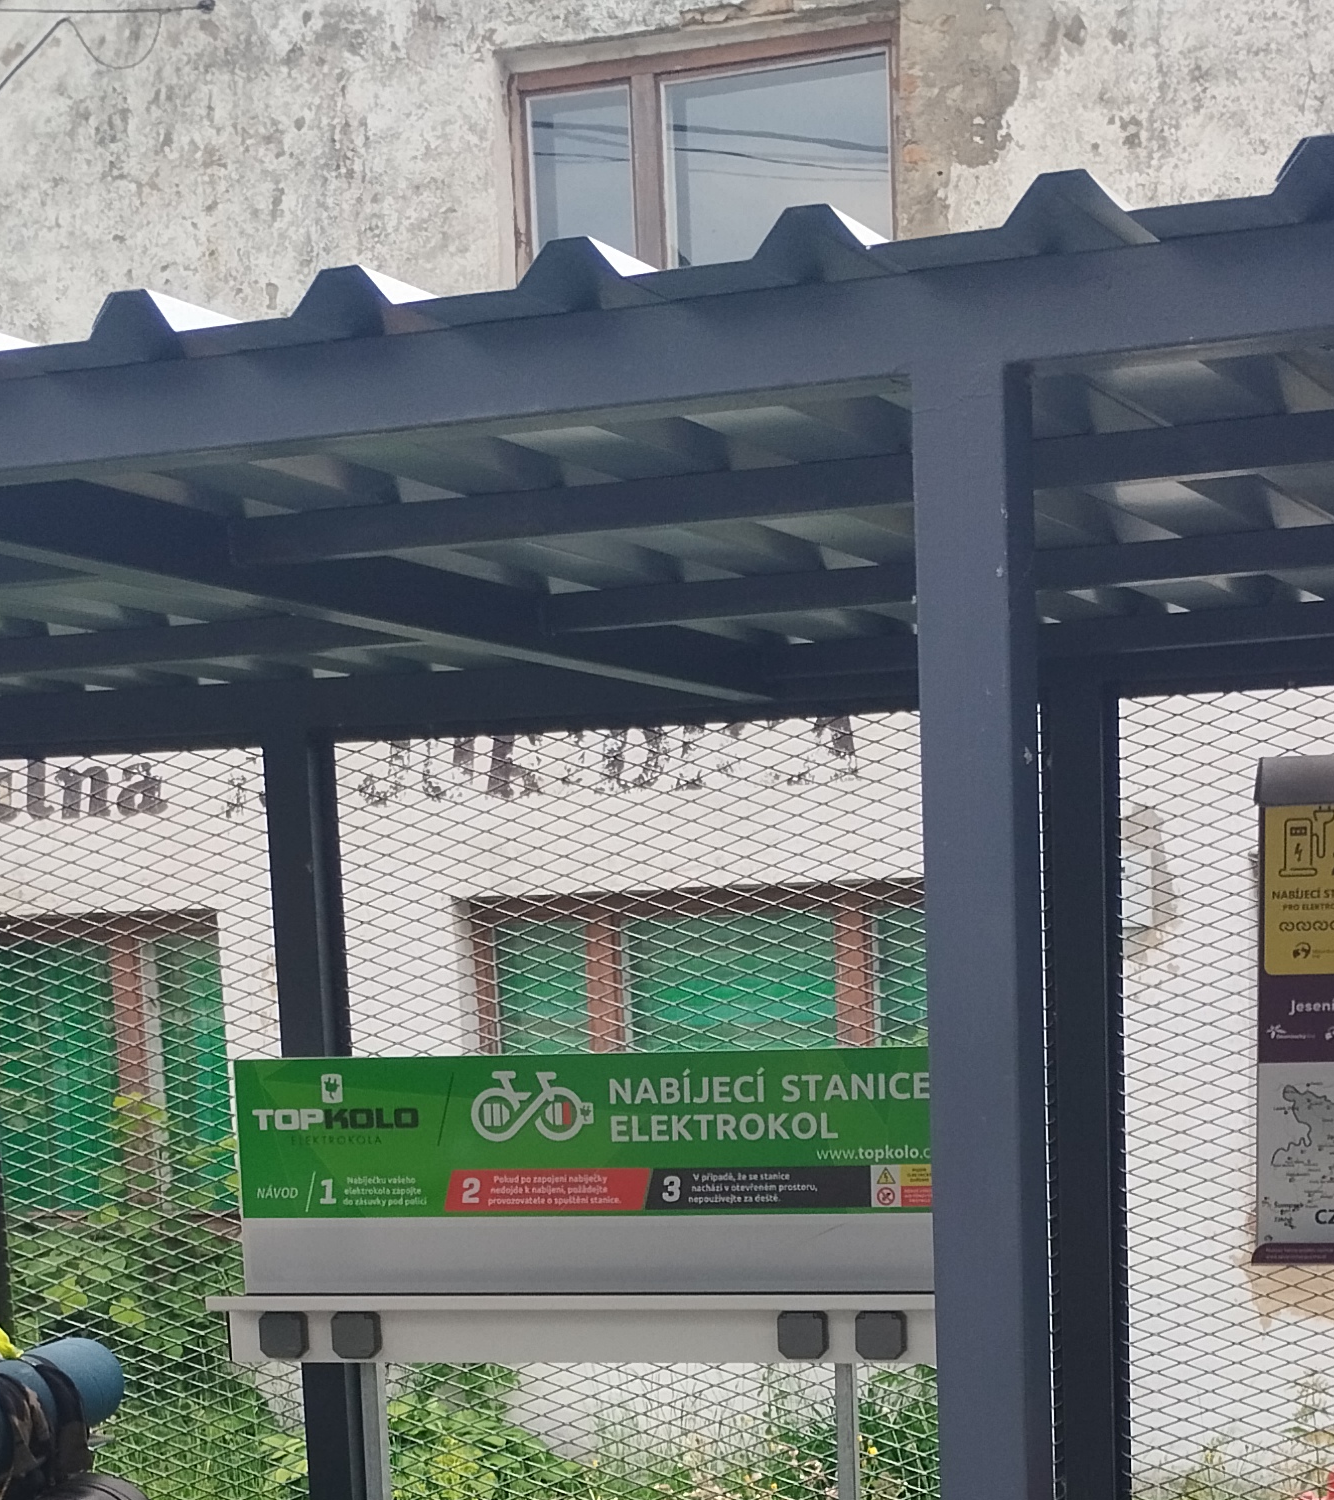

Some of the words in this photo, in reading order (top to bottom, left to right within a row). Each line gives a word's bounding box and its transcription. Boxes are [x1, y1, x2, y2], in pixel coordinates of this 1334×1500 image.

[1272, 887, 1321, 900] NABÍJECÍ
[1282, 903, 1299, 911] PRO
[609, 1067, 765, 1105] NABÍJECÍ
[782, 1072, 931, 1101] STANICE
[252, 1108, 419, 1131] TOPKOLO
[611, 1112, 838, 1142] ELEKTROKOL
[291, 1135, 382, 1146] ELEKTROKOLA
[347, 1175, 386, 1186] Nabíječku
[388, 1175, 416, 1185] vašeho
[494, 1175, 519, 1184] Pokud
[521, 1176, 531, 1185] po
[533, 1174, 567, 1185] zapojení
[568, 1173, 607, 1184] nabíječky
[692, 1173, 700, 1181] V
[701, 1173, 736, 1183] případě,
[737, 1172, 747, 1181] že
[760, 1171, 790, 1181] stanice
[256, 1184, 299, 1199] NÁVOD
[320, 1178, 337, 1205] 1
[344, 1186, 390, 1196] elektrokola
[392, 1187, 422, 1198] zapojte
[462, 1177, 481, 1204] 2
[490, 1185, 523, 1196] nedojde
[524, 1185, 530, 1194] k
[567, 1184, 608, 1195] požádejte
[662, 1175, 681, 1202] 3
[691, 1183, 723, 1192] nachází
[731, 1182, 777, 1192] otevřeném
[778, 1183, 818, 1193] prostoru,
[343, 1197, 351, 1206] do
[354, 1197, 386, 1207] zásuvky
[388, 1197, 403, 1207] pod
[488, 1196, 545, 1207] provozovatele
[554, 1195, 589, 1206] spuštění
[590, 1195, 622, 1204] stanice.
[688, 1194, 742, 1205] nepoužívejte
[743, 1195, 753, 1203] za
